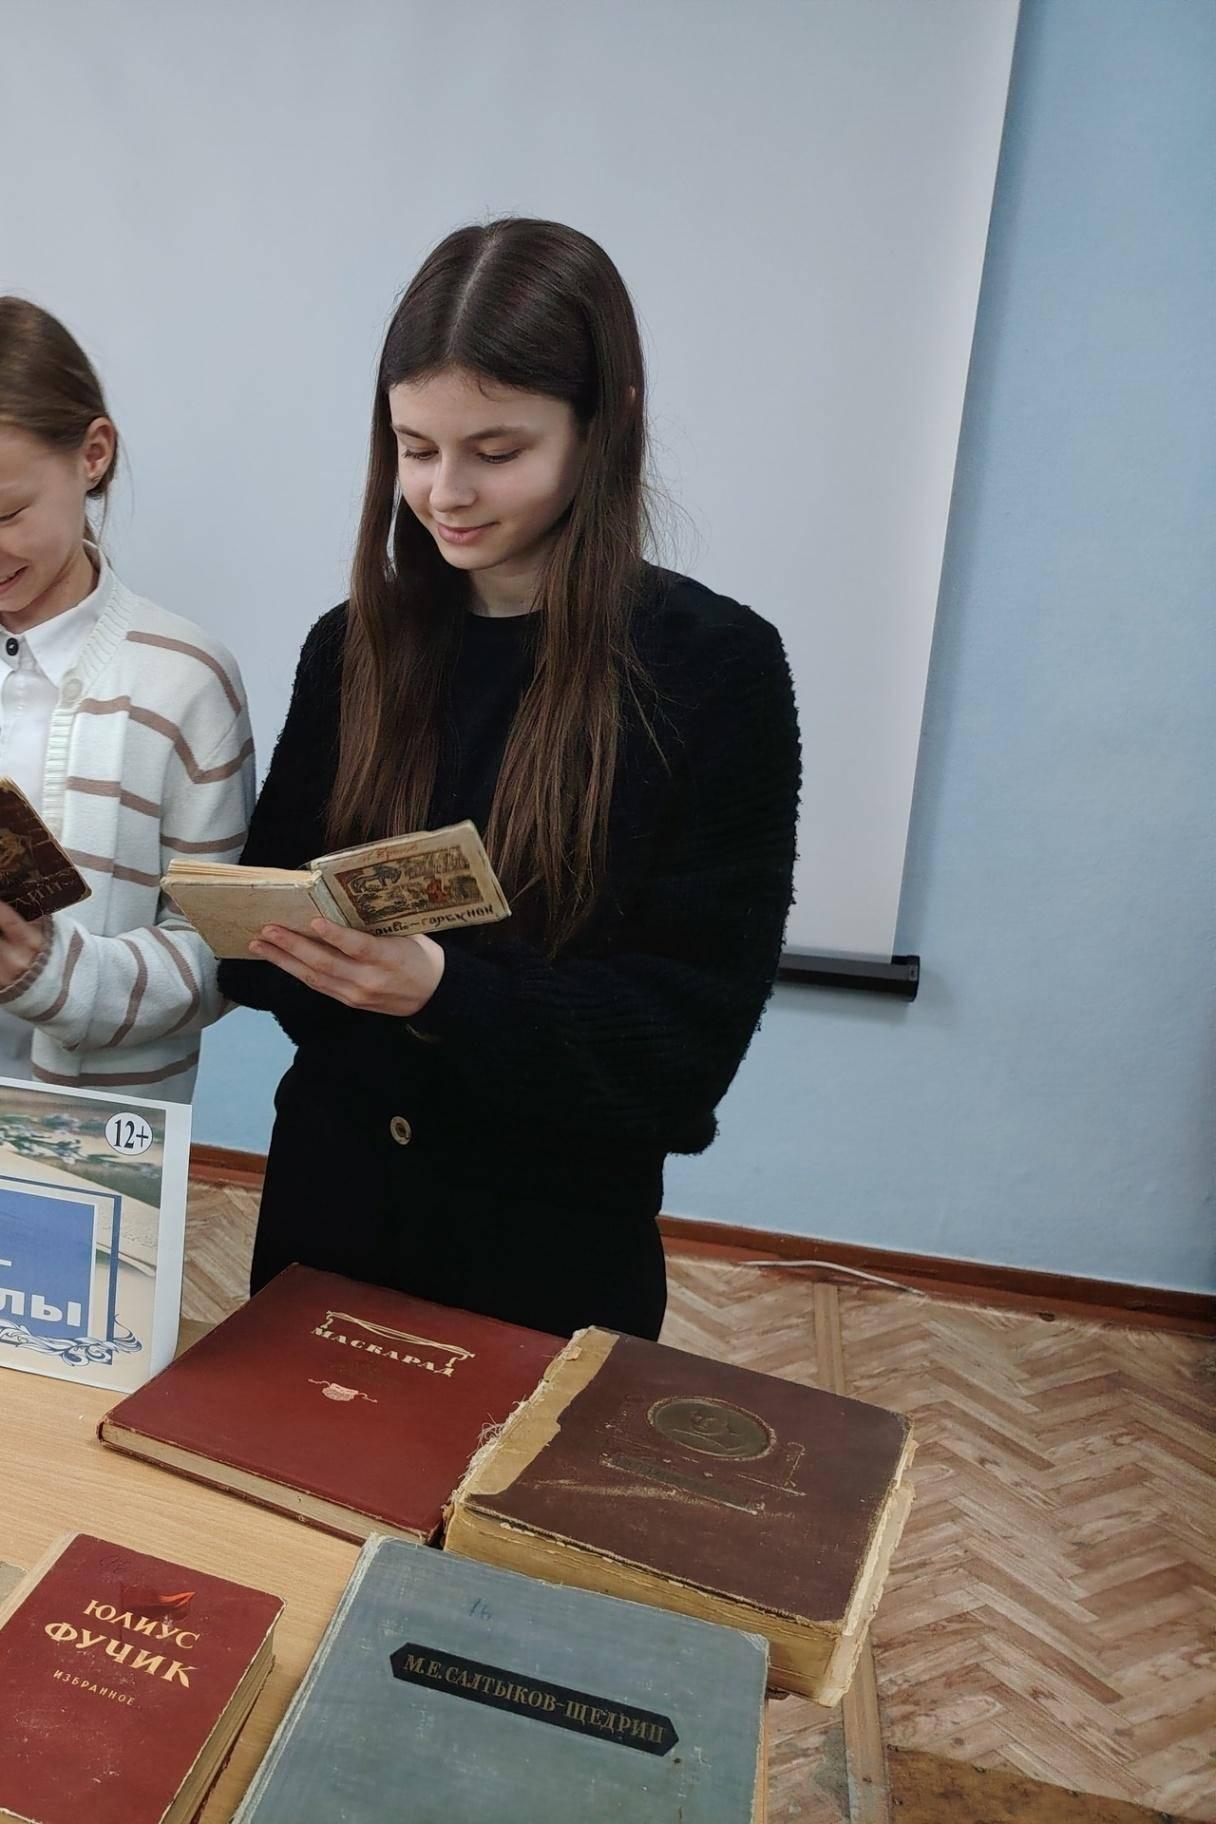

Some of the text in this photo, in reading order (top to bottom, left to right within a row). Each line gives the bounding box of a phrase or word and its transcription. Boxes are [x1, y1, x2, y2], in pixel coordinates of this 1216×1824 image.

[111, 1117, 150, 1150] 12+
[310, 1326, 456, 1378] МАСКАРАД
[83, 1599, 201, 1650] ЮЛИУС
[43, 1620, 199, 1690] ФУЧИК
[52, 1669, 135, 1707] ИЗБРАННОЕ
